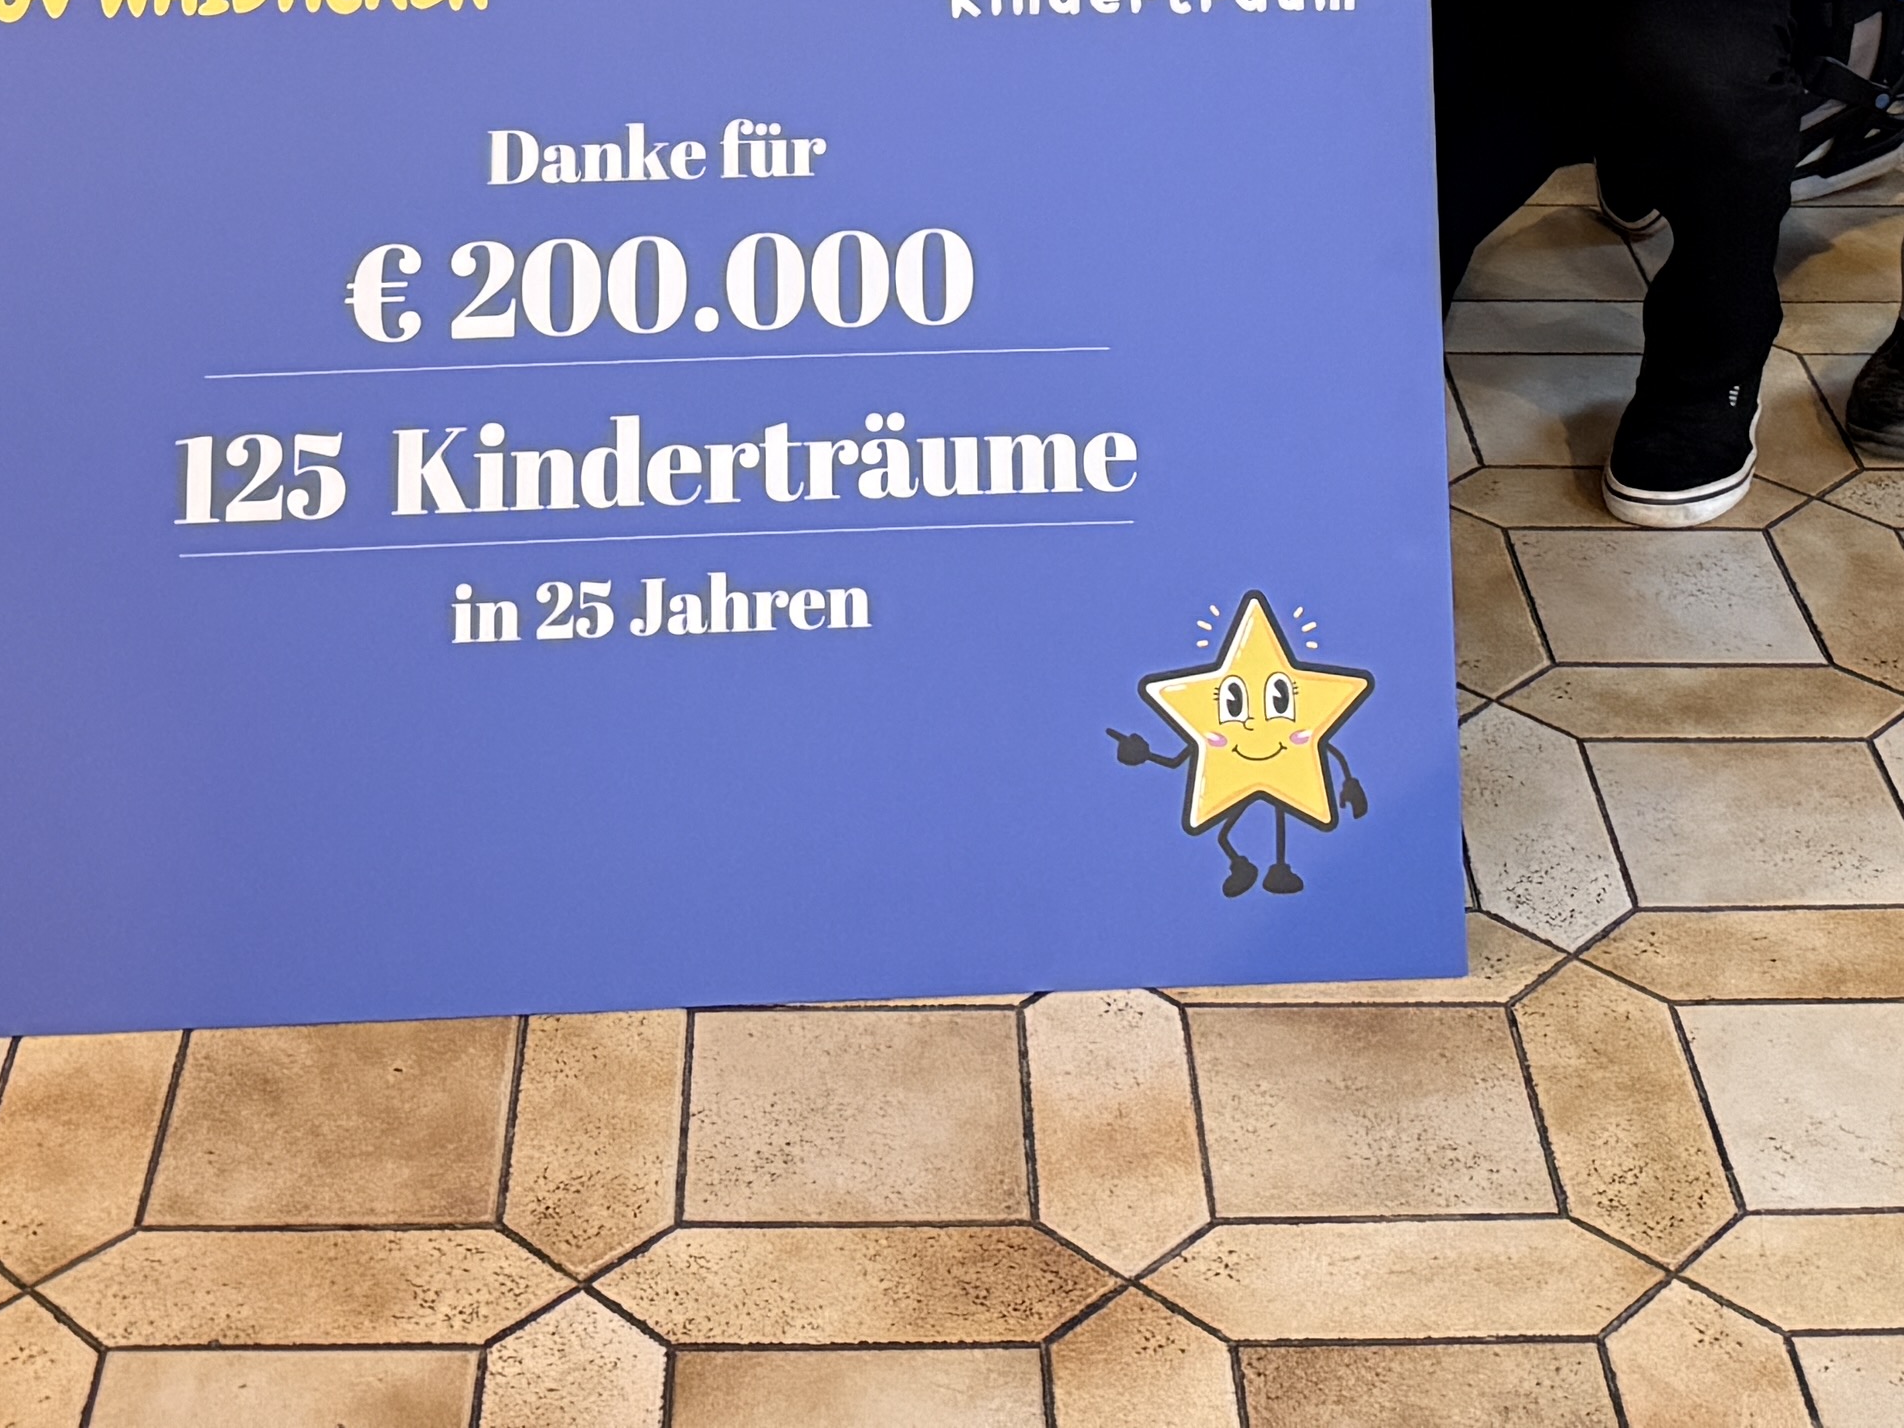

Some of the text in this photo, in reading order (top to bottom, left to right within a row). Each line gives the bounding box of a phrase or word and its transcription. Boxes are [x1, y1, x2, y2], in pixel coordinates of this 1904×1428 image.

[486, 117, 828, 187] Danke für
[343, 227, 976, 344] € 200.000
[172, 411, 1139, 527] 125 Kinderträume
[450, 569, 873, 645] in 25 Jahren
